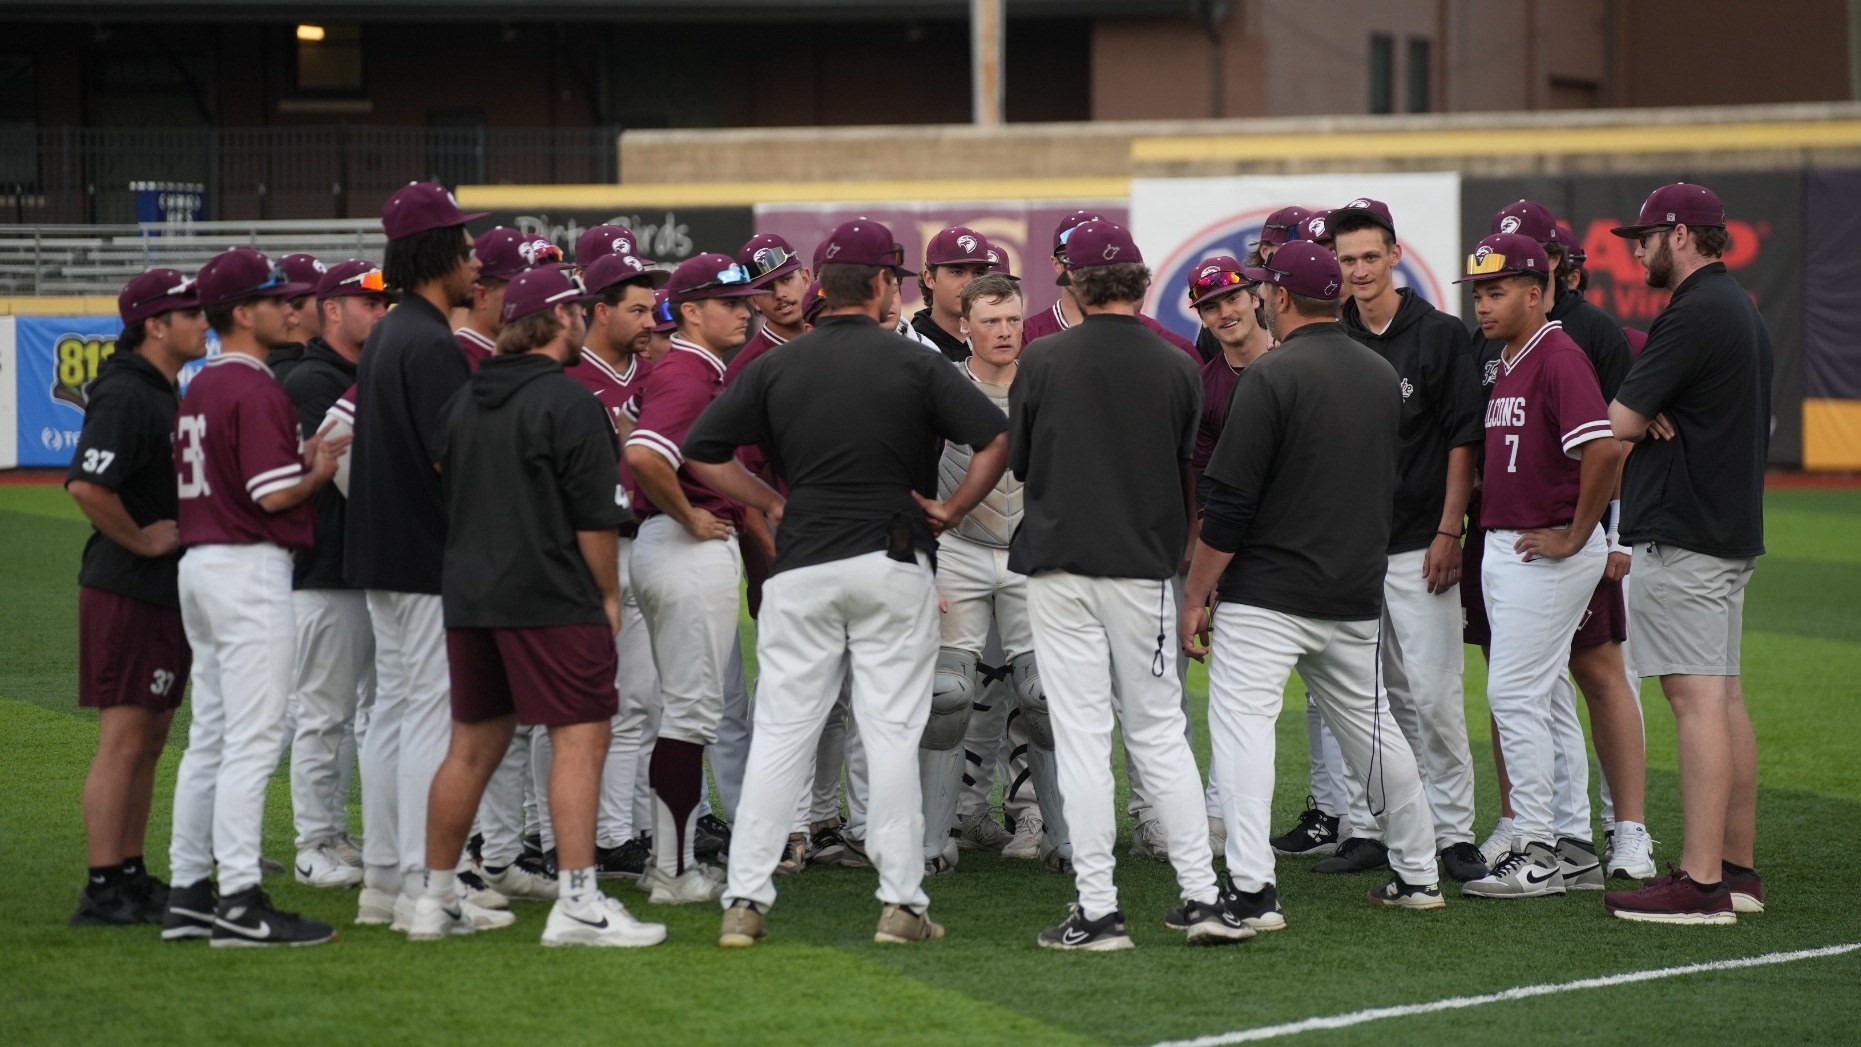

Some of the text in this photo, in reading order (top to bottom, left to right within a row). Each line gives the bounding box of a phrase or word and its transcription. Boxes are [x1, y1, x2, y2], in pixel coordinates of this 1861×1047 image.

[81, 447, 115, 475] 37
[1505, 434, 1520, 473] 7
[150, 669, 174, 696] 37
